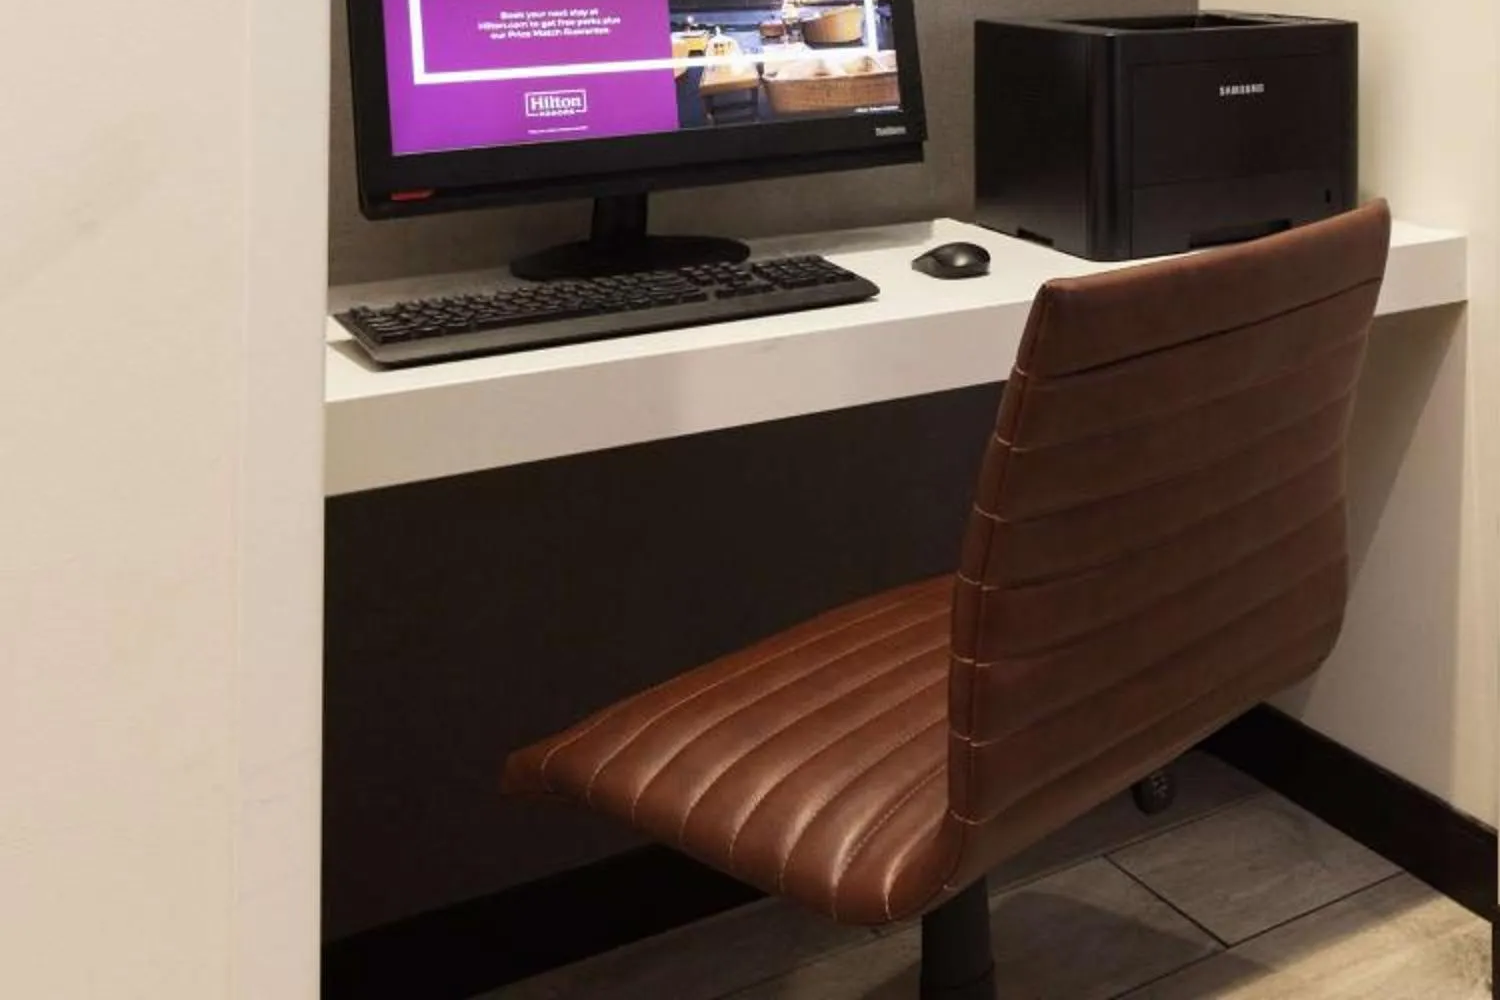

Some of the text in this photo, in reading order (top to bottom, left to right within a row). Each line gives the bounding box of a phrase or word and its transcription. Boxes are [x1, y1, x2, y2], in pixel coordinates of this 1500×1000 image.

[526, 11, 546, 20] your
[569, 8, 589, 18] stay
[541, 20, 557, 28] get
[557, 18, 575, 26] free
[1219, 83, 1265, 96] SAMSUNG
[530, 95, 582, 111] Hilton
